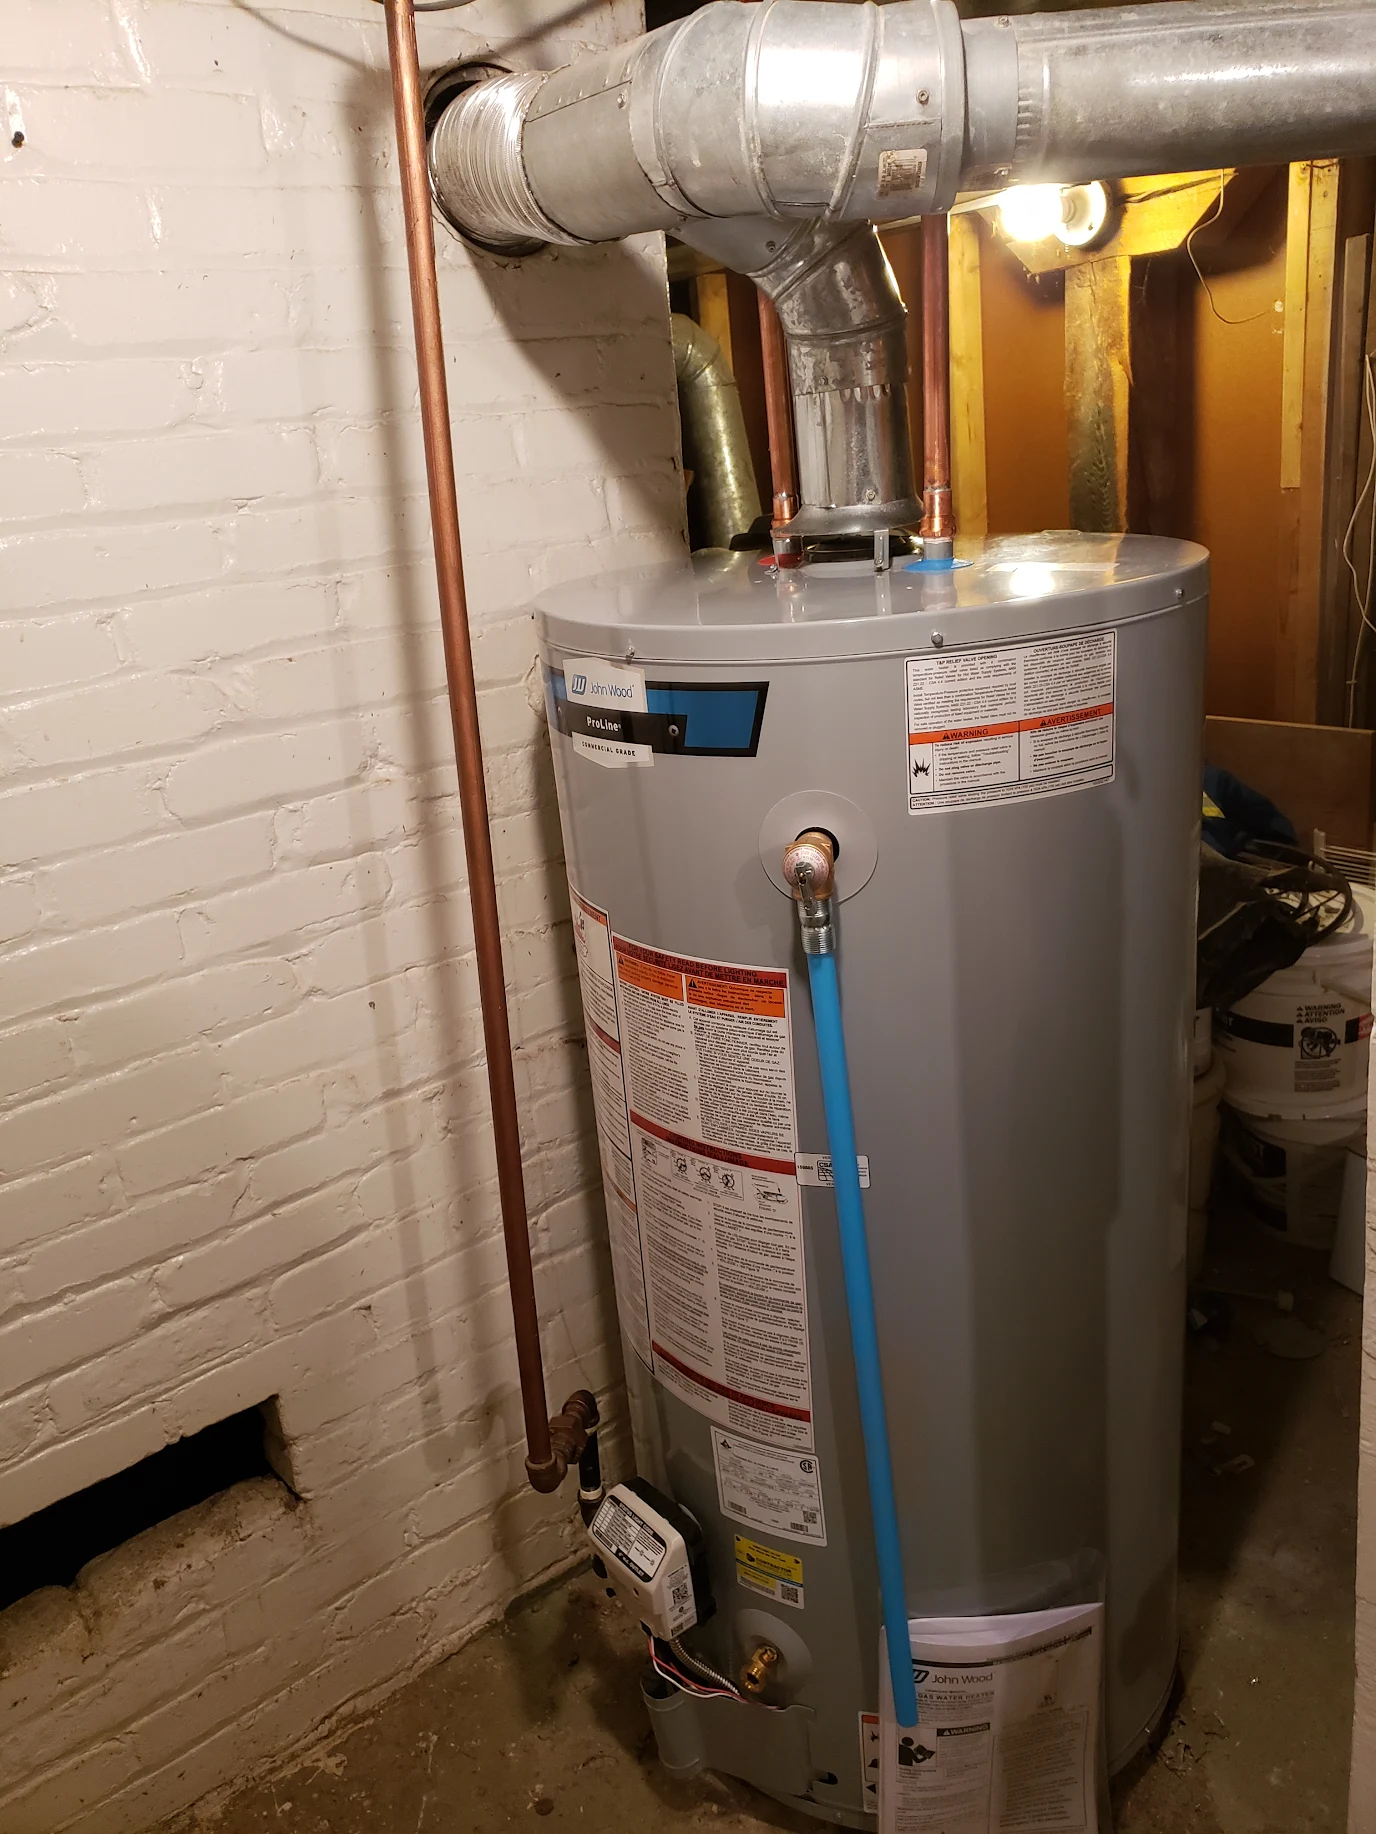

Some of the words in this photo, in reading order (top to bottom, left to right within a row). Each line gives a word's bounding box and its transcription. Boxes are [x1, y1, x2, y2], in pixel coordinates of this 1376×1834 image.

[590, 682, 607, 696] John
[608, 684, 632, 698] Wood
[1048, 709, 1102, 726] AVERTISSEMENT
[950, 728, 988, 740] WARNING
[582, 740, 613, 754] COMMERCIAL
[615, 747, 636, 757] GRADE
[677, 957, 694, 967] READ
[696, 963, 723, 974] BEFORE
[724, 967, 757, 977] LIGHTING
[715, 973, 740, 981] METTRE
[754, 978, 784, 986] MARCHE
[1304, 1003, 1342, 1011] WARNING
[1304, 1009, 1345, 1017] ATTENTION
[932, 1674, 959, 1684] John
[962, 1672, 993, 1684] Wood
[950, 1724, 990, 1735] WARNING
